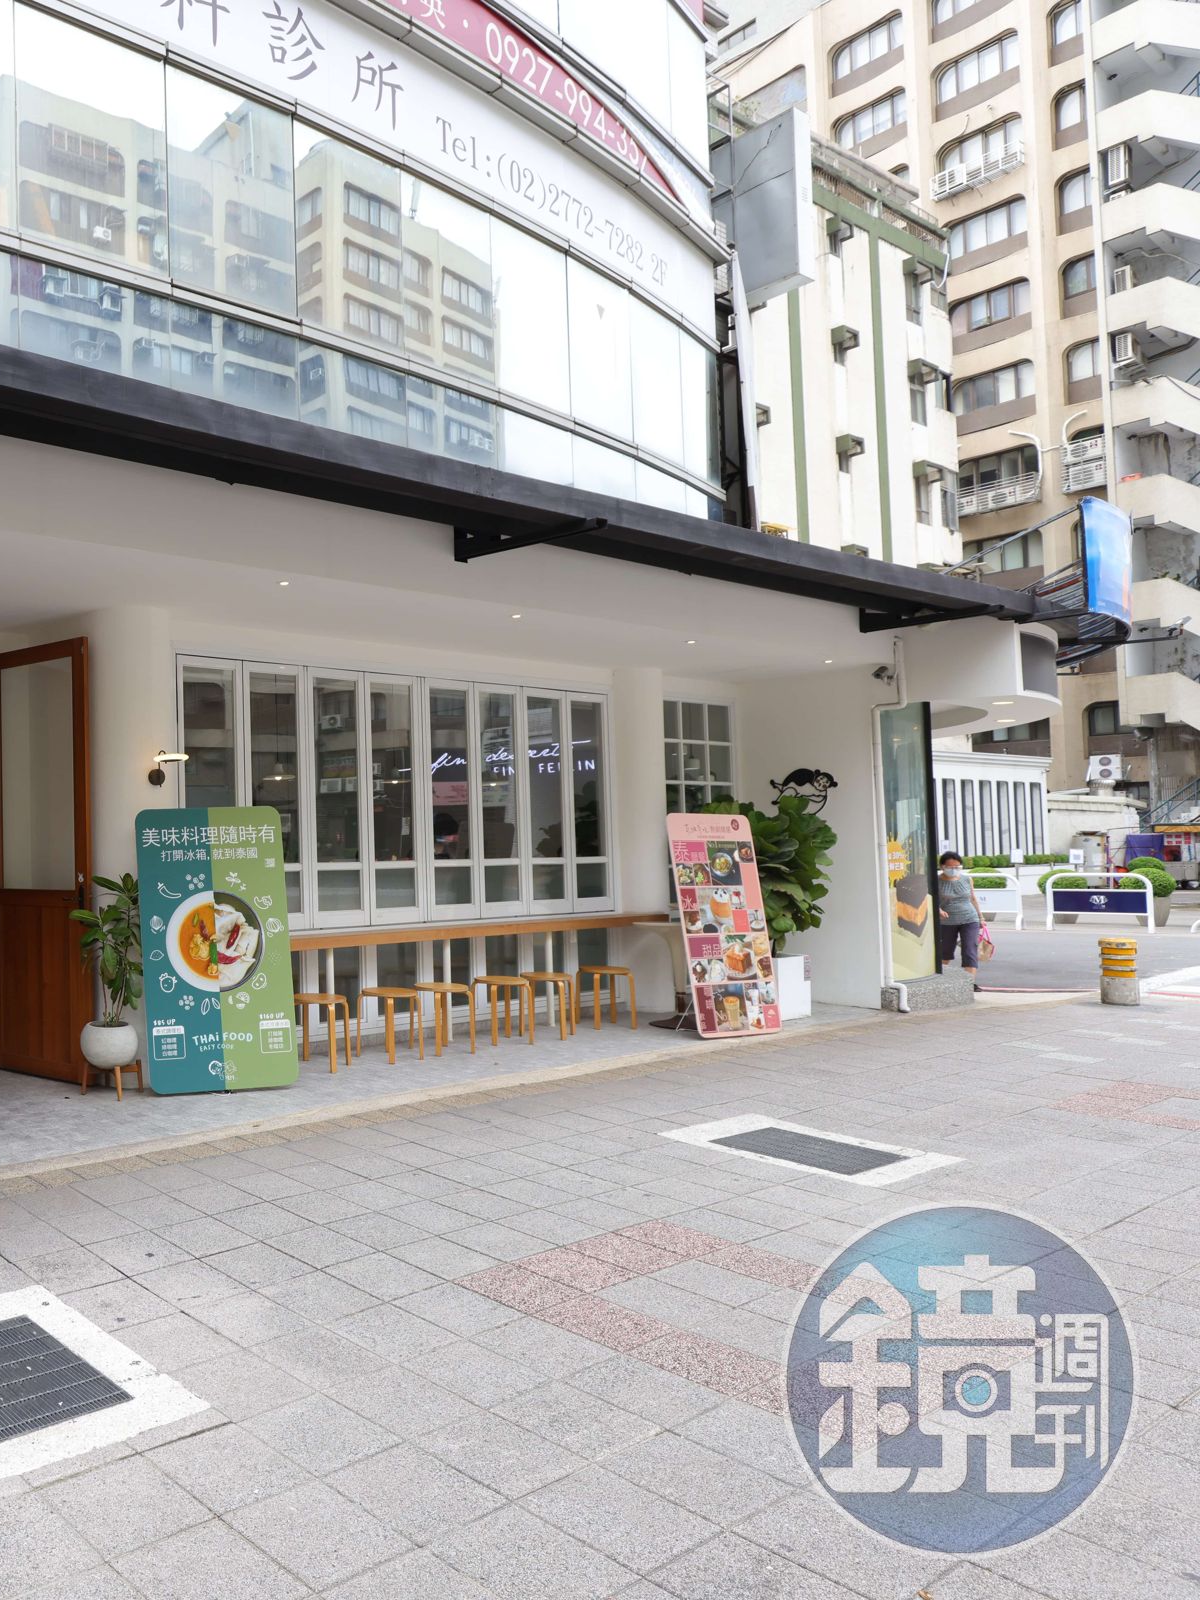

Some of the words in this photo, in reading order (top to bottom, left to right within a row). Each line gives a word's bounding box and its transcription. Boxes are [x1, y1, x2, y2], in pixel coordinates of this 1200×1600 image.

[142, 824, 276, 847] 美味料理隨時有
[222, 1032, 254, 1043] FOOD
[199, 1044, 216, 1052] EASY
